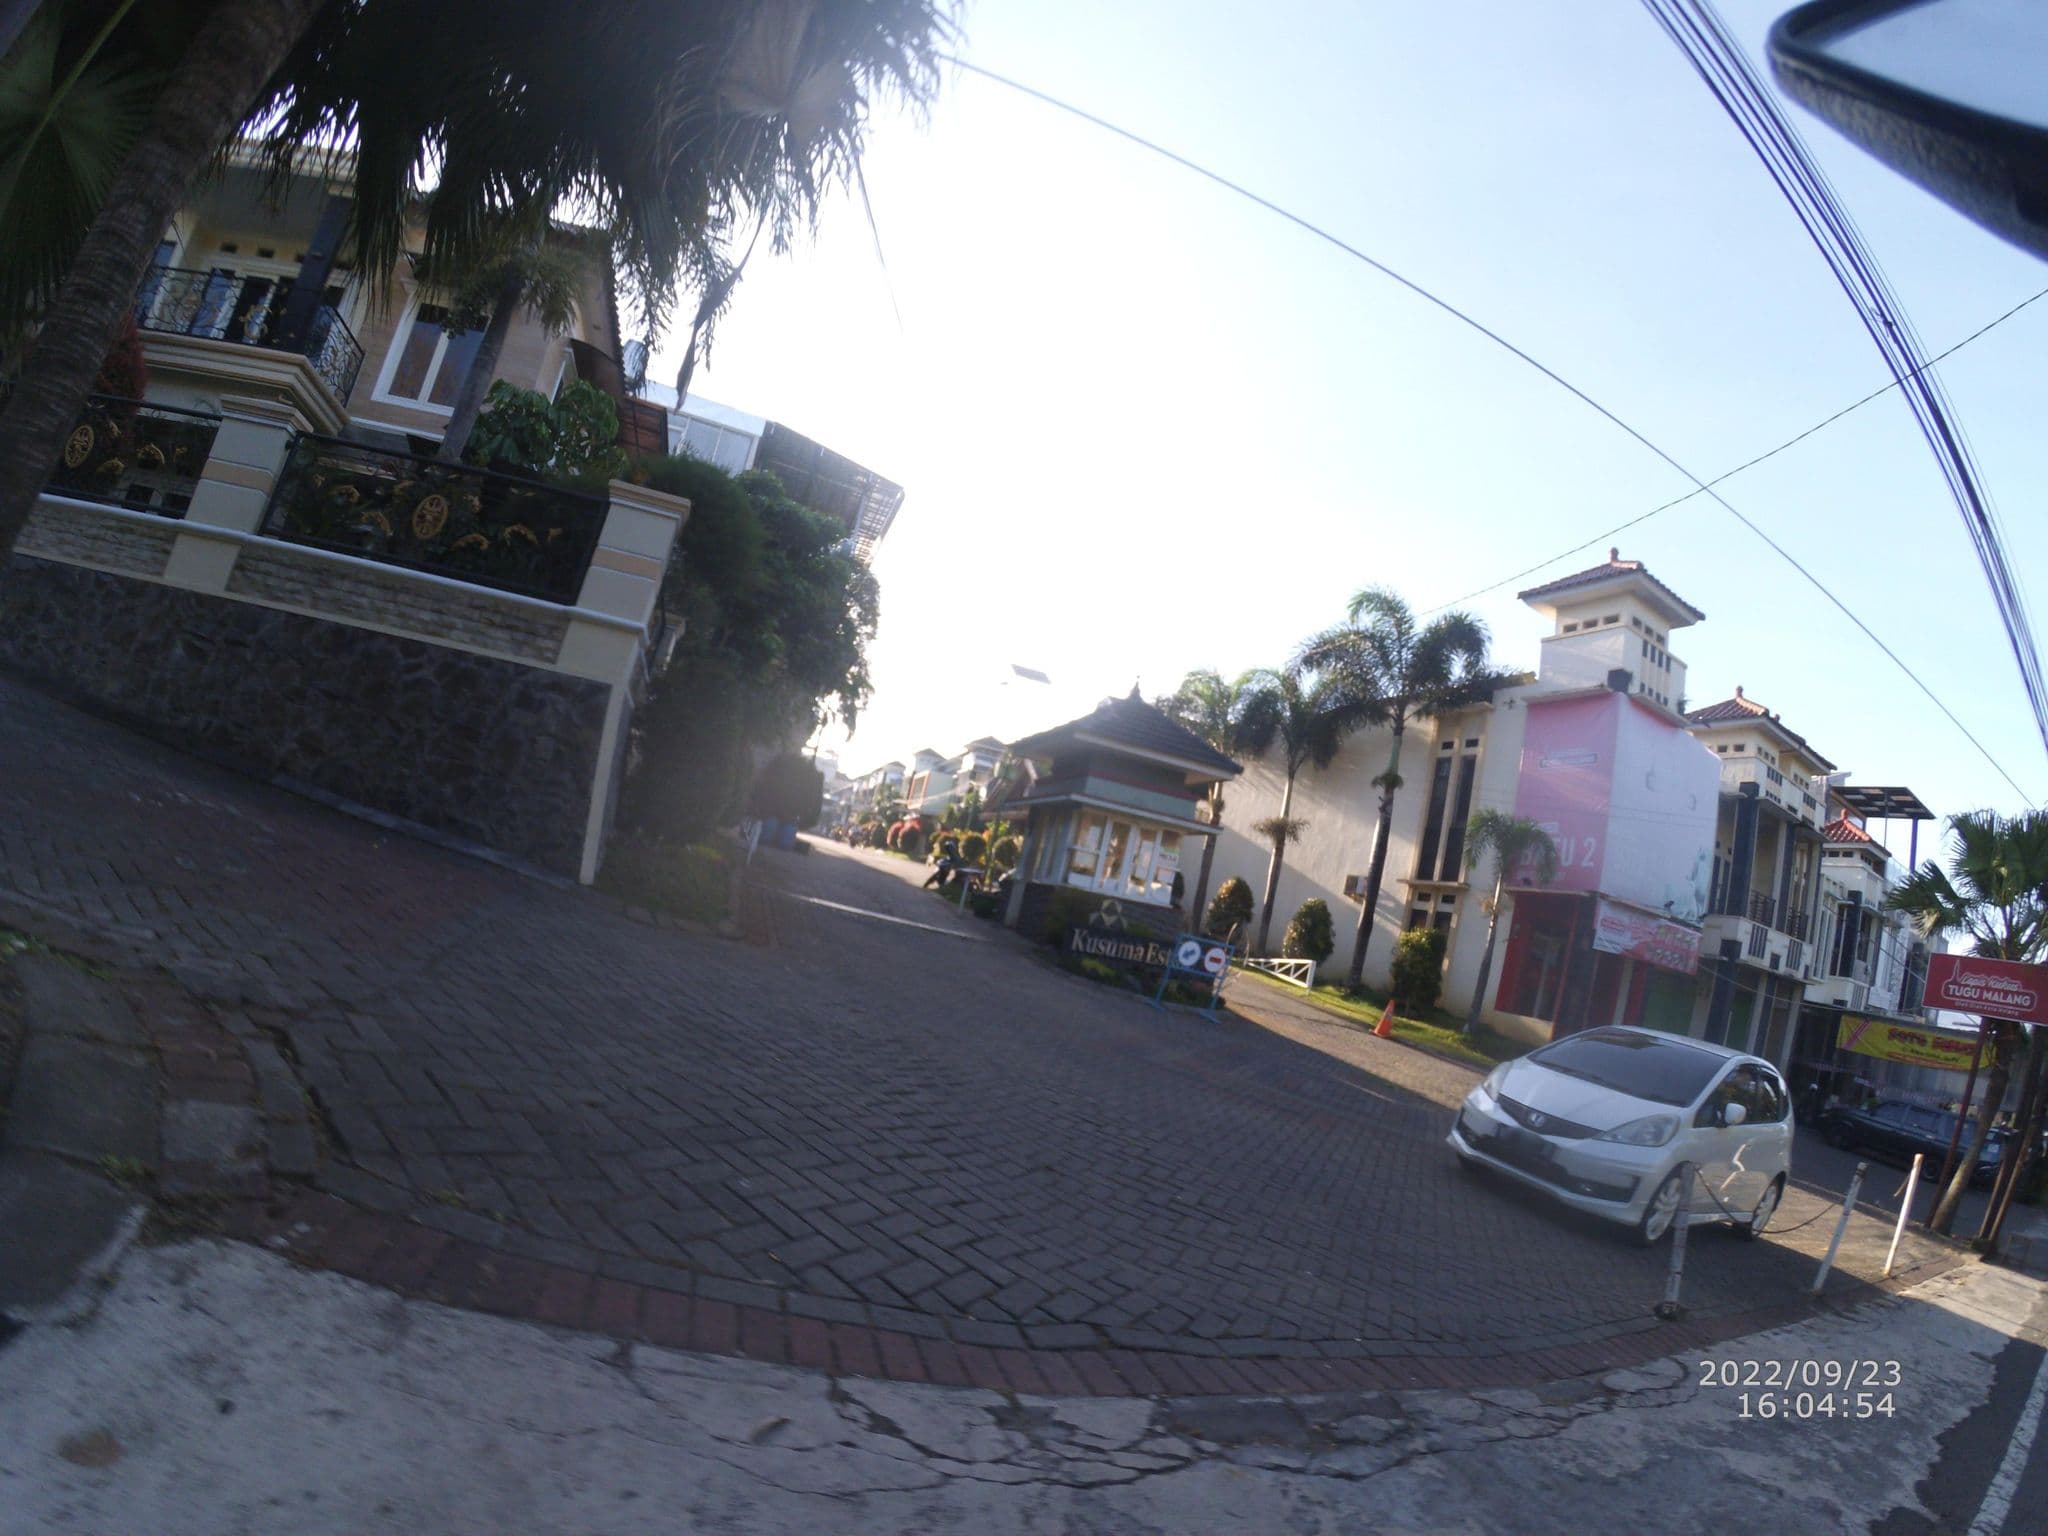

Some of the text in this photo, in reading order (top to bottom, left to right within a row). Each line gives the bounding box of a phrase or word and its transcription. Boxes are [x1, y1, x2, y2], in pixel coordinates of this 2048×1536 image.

[1581, 837, 1597, 868] 2
[1072, 929, 1144, 961] Kusuma
[1948, 985, 2031, 1007] TUGU MALANG
